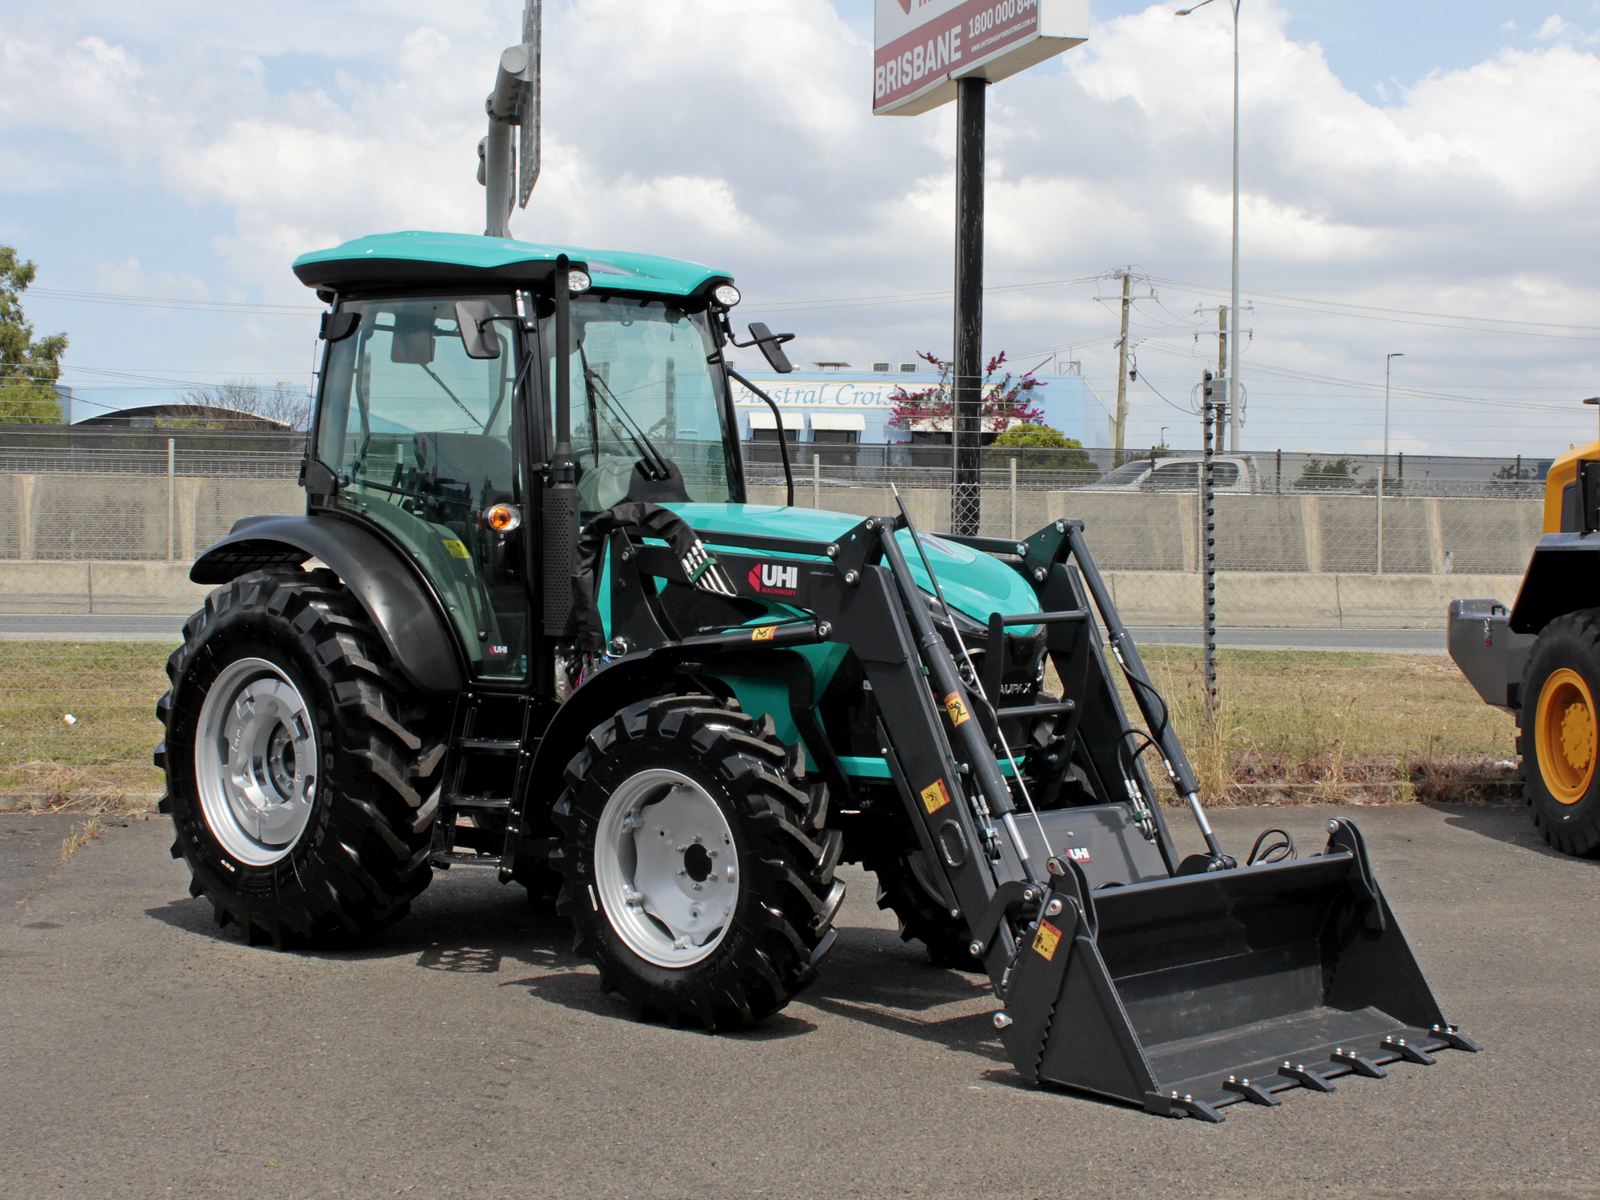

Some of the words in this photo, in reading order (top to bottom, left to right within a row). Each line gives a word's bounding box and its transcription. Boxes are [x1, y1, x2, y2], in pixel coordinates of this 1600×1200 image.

[968, 8, 994, 39] 1800
[995, 0, 1016, 25] 000
[1016, 0, 1037, 14] 84
[875, 25, 962, 100] BRISBANE
[835, 383, 897, 406] Crois
[762, 564, 798, 589] UHI
[493, 645, 508, 653] UHI
